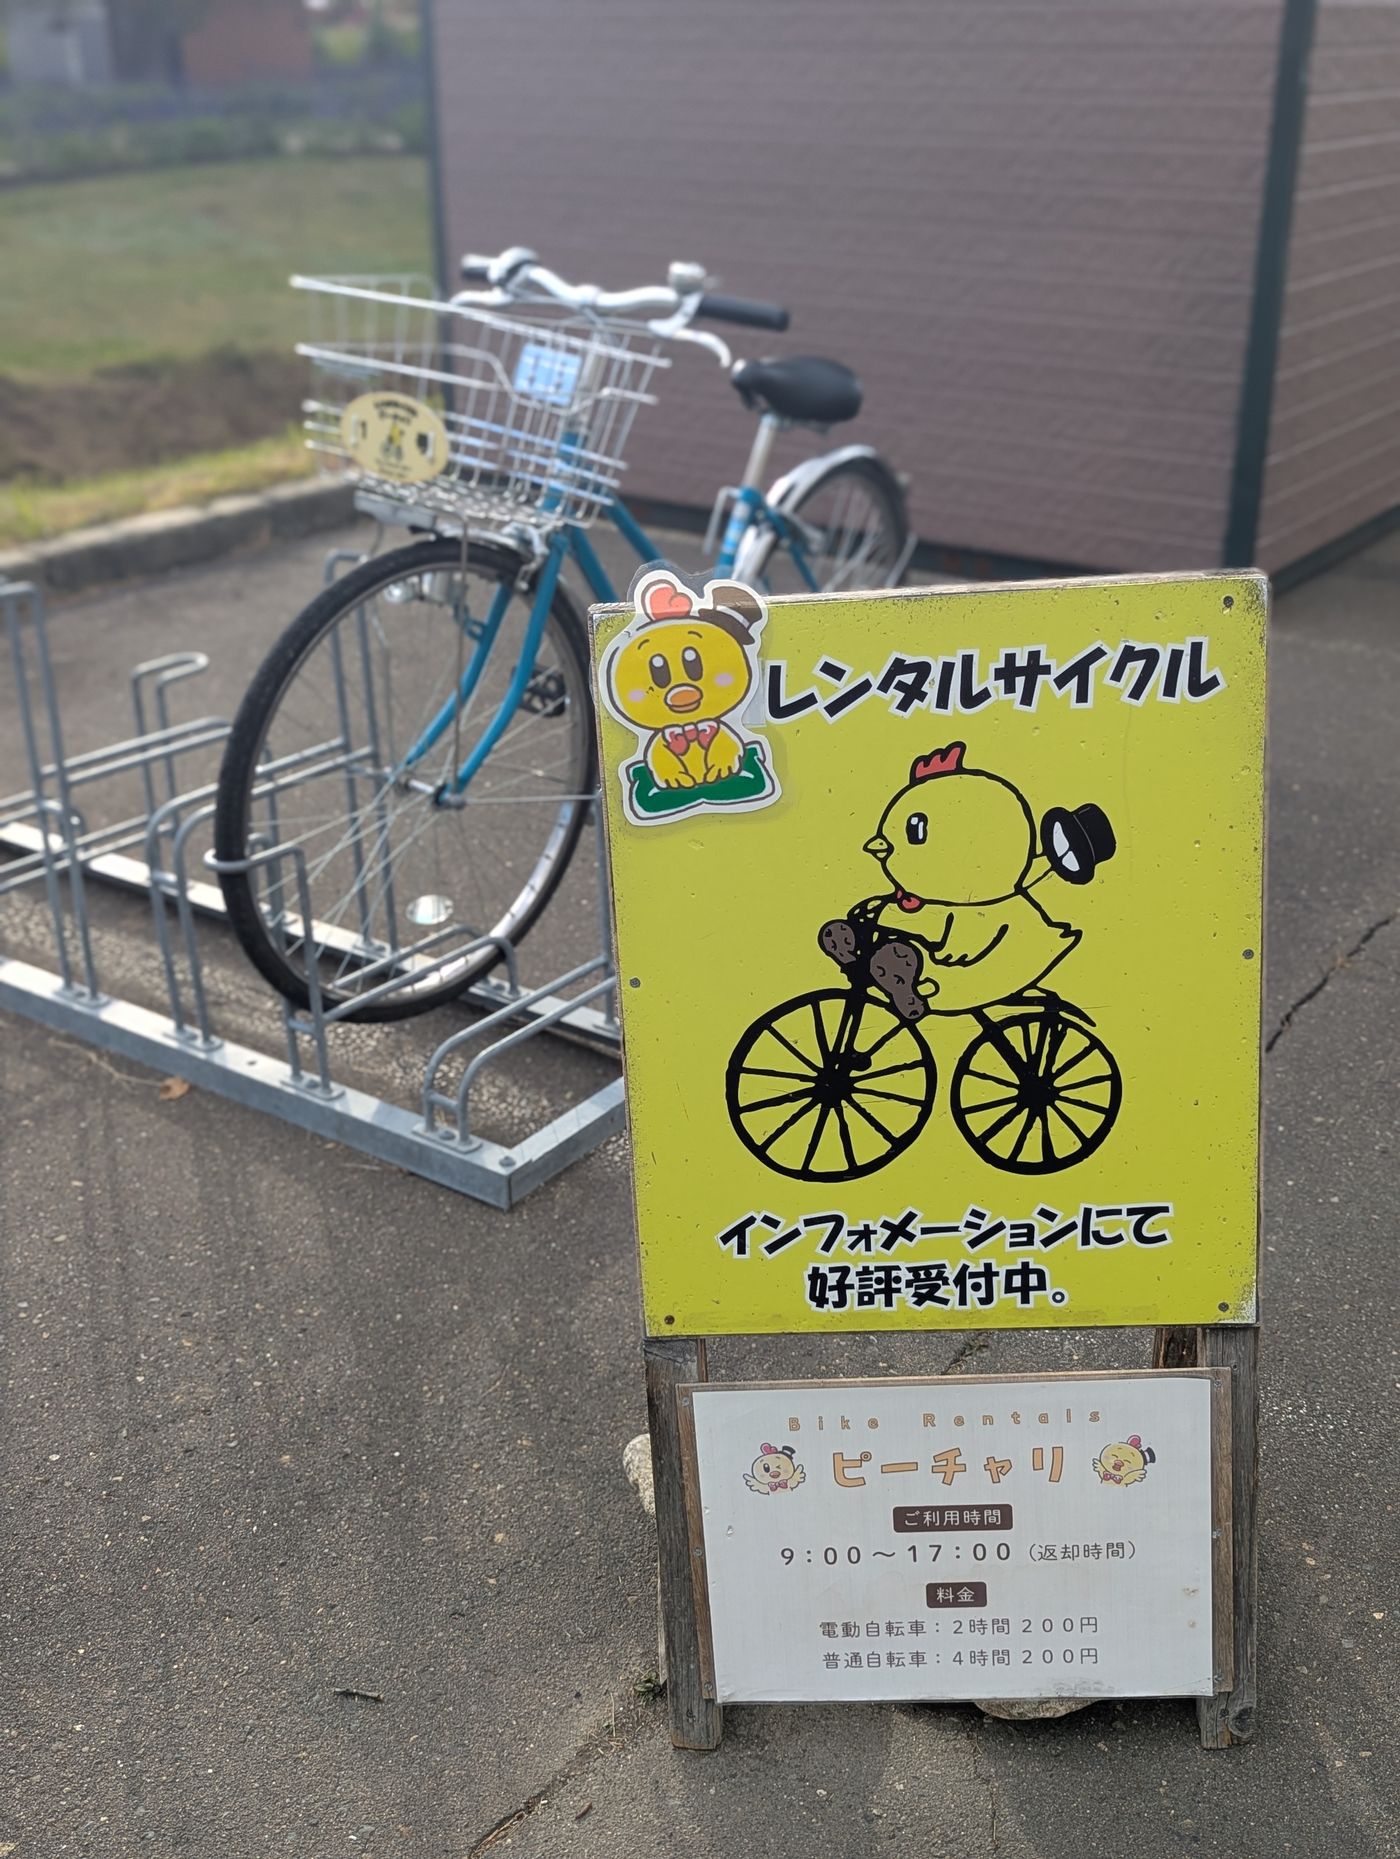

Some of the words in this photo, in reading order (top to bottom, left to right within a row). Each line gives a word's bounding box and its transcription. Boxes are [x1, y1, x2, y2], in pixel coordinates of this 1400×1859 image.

[766, 640, 1222, 720] レンタルサイクル
[718, 1203, 1171, 1257] インフォメーションにて
[807, 1260, 1067, 1309] 好評受付中。
[788, 1415, 879, 1432] Bike
[922, 1408, 1101, 1428] Rentals
[832, 1446, 1064, 1488] ピーチャリ
[904, 1508, 1002, 1528] ご利用時間
[936, 1585, 976, 1604] 料金
